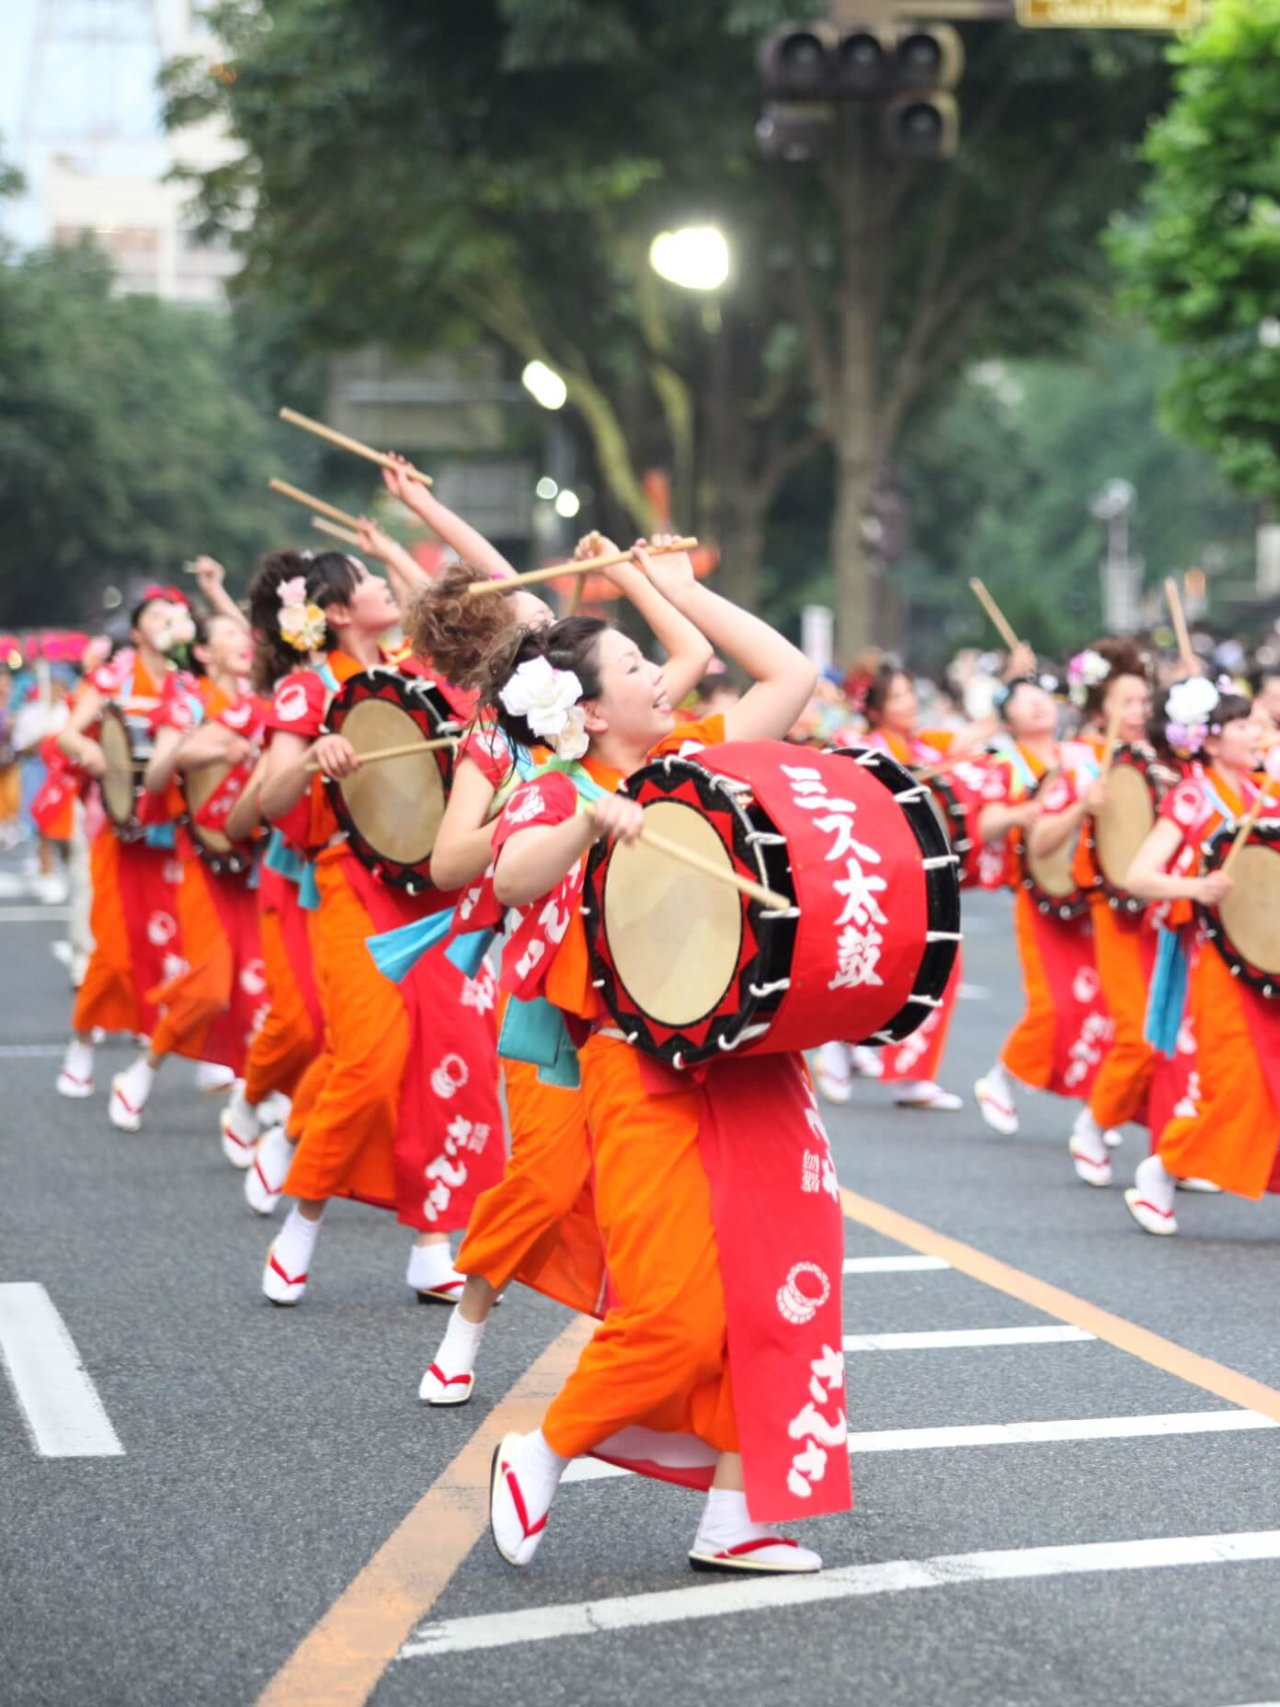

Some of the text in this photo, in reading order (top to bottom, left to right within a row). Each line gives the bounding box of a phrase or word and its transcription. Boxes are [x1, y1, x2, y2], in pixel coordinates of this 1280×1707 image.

[780, 764, 889, 990] ミス太鼓
[423, 1114, 471, 1222] さんさ
[787, 1344, 847, 1497] さんさ
